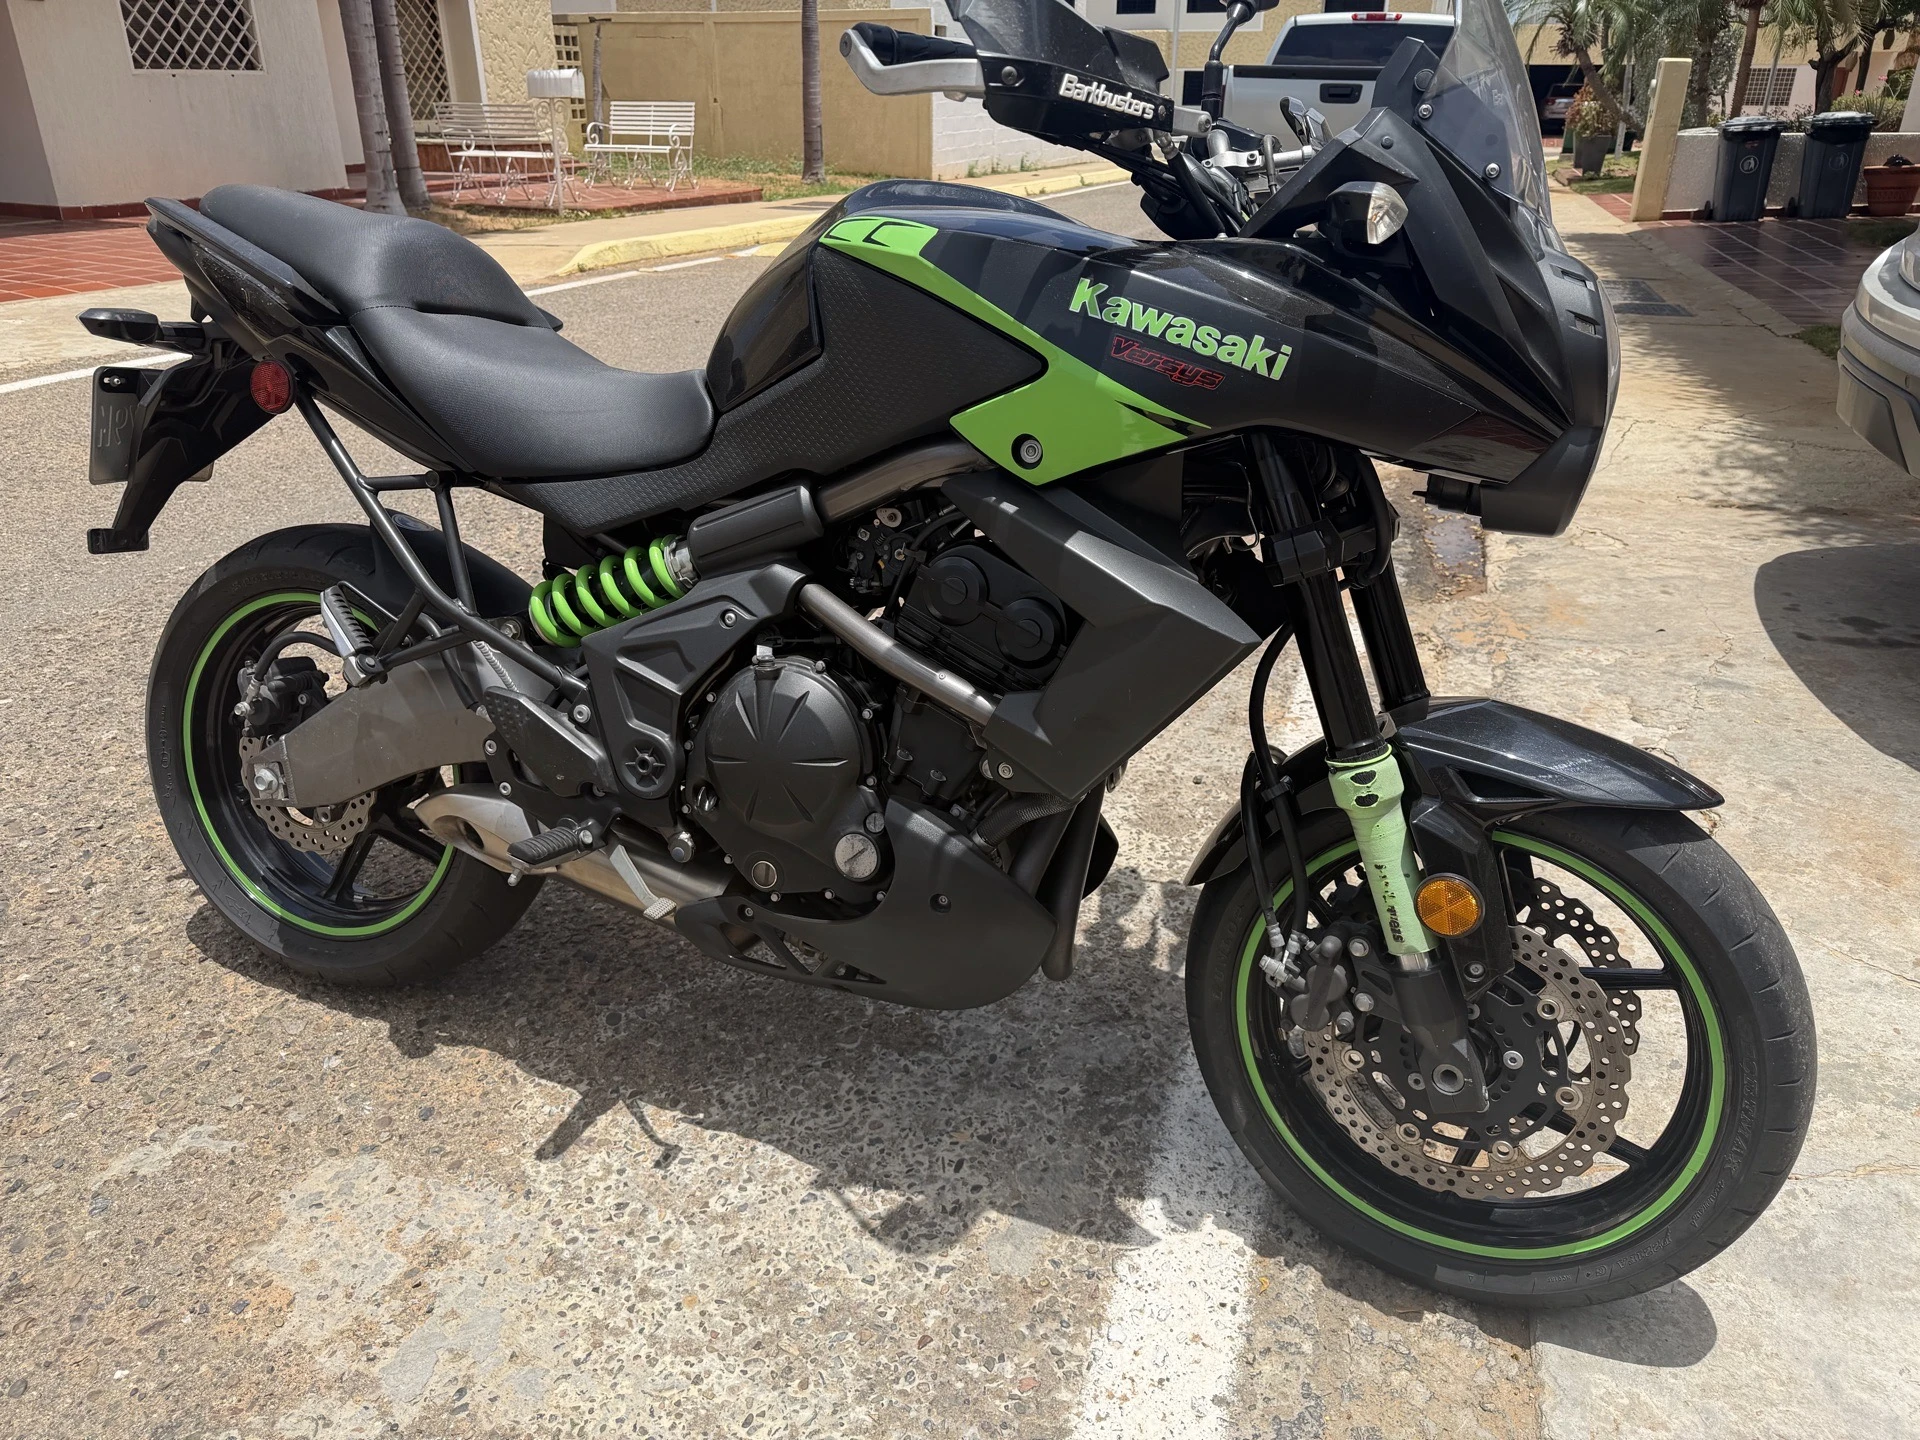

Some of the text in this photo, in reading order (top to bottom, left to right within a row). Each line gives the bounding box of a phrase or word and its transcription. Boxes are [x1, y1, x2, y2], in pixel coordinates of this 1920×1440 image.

[1059, 73, 1155, 120] Barkbusters
[1069, 277, 1293, 381] Kawasaki
[1110, 335, 1225, 390] Versys
